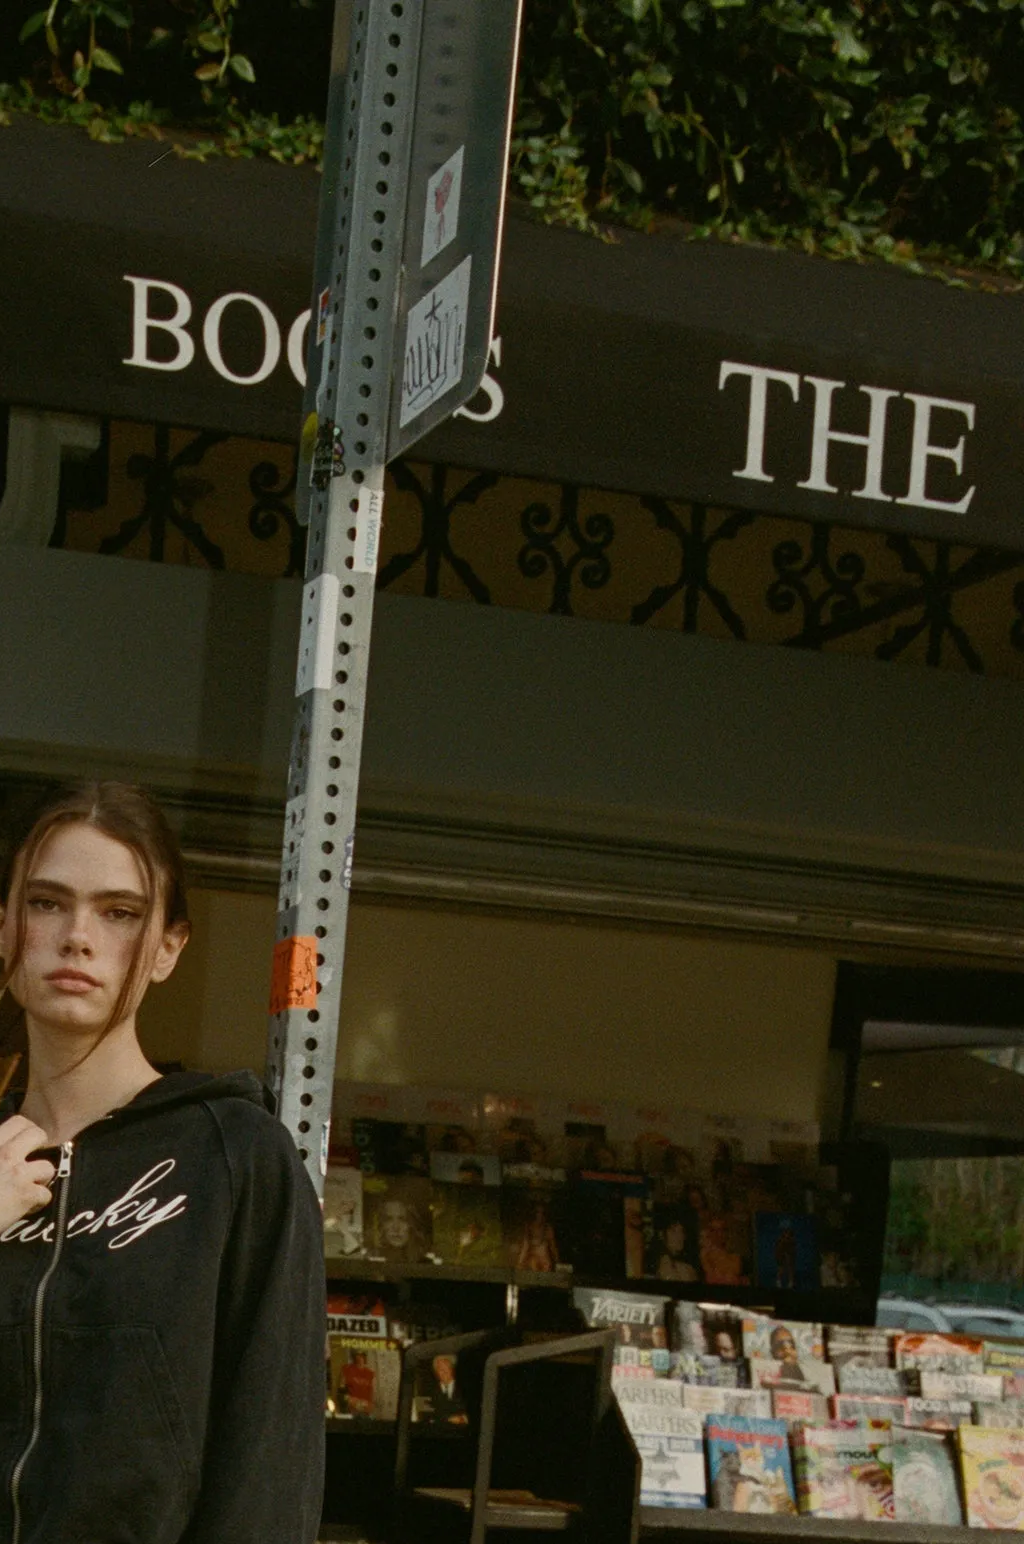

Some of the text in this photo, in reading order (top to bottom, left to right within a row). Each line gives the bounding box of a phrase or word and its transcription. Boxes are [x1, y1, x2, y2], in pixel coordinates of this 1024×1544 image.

[122, 273, 505, 422] BOS
[718, 360, 978, 515] THE
[0, 1158, 188, 1249] ucky
[590, 1296, 658, 1325] VARIETY
